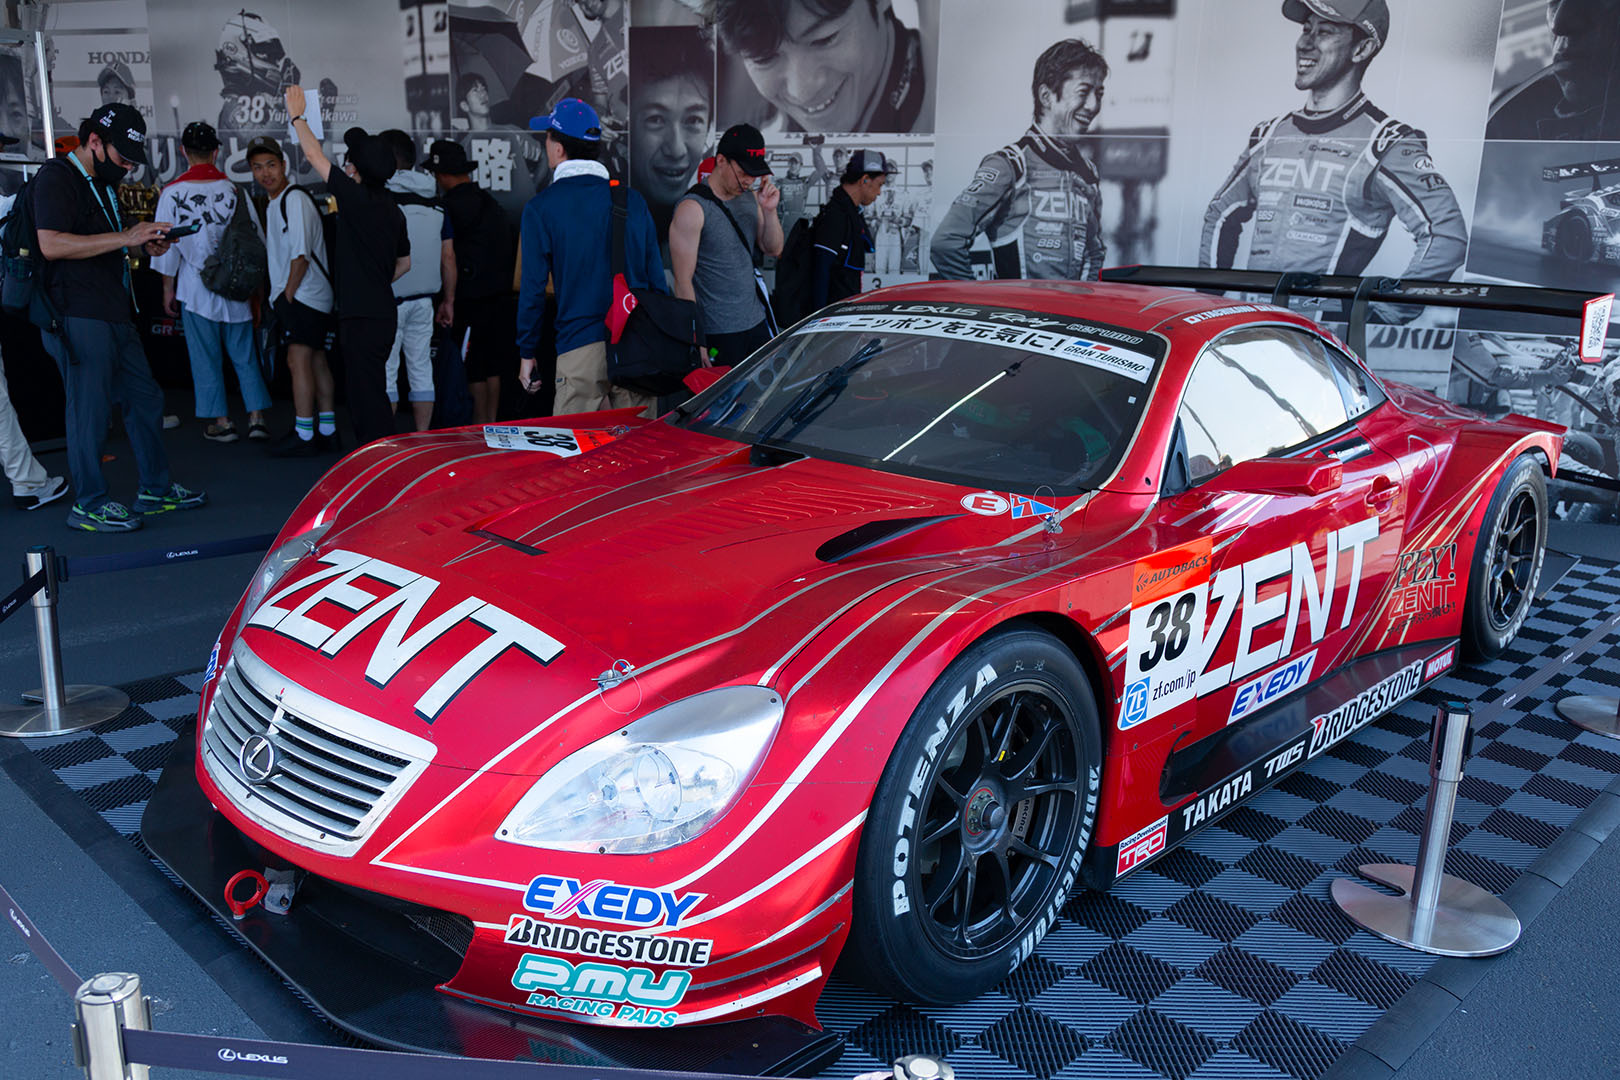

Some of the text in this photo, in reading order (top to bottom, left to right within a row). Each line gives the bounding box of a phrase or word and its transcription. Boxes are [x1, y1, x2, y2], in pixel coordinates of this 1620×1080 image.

[236, 95, 265, 123] 38
[1260, 157, 1345, 192] ZENT
[1034, 190, 1088, 223] ZENT
[1037, 238, 1061, 250] BBS
[871, 277, 882, 289] 3
[892, 304, 981, 317] LEXUS
[1066, 323, 1144, 345] cerumo
[1063, 345, 1096, 359] GRAN
[1099, 351, 1146, 373] TURISMO
[1150, 554, 1209, 584] AUTOBACS
[1393, 542, 1457, 590] FLY!
[1196, 515, 1380, 699] ZENT
[1388, 579, 1456, 620] ZENT
[246, 549, 567, 723] ZENT
[1139, 592, 1196, 673] 38
[1425, 649, 1453, 679] MOTUL
[1127, 686, 1146, 717] ZF
[1153, 669, 1197, 701] zf.com/jp
[1231, 653, 1314, 717] EXEDY
[1309, 660, 1423, 757] BRIDGESTONE
[1264, 741, 1306, 778] TWS
[892, 663, 999, 916] POTENZA
[1183, 770, 1252, 831] TAKATA
[1120, 818, 1167, 850] Racing Development
[1120, 831, 1164, 866] TRD
[1008, 763, 1101, 974] BRIDGESTONE
[525, 876, 701, 927] EXEDY
[507, 916, 709, 966] BRIDGESTONE
[527, 992, 679, 1028] RACING PADS
[237, 1052, 289, 1065] LEXUS
